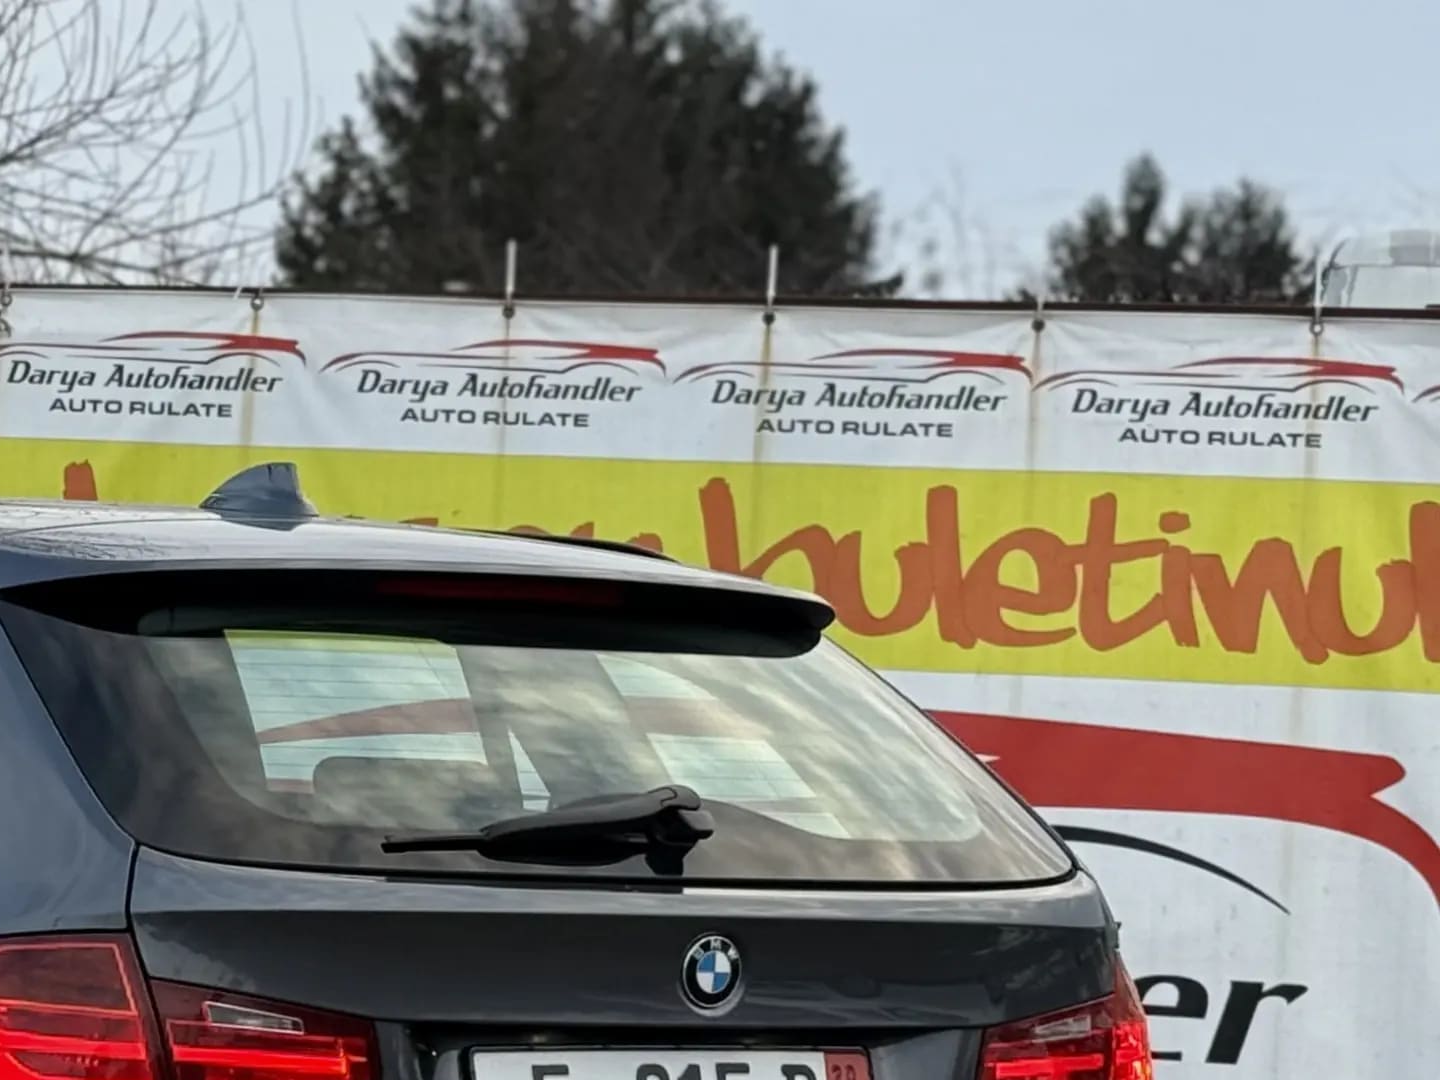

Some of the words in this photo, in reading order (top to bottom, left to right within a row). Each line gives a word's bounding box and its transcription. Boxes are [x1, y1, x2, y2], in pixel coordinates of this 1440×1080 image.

[6, 360, 96, 393] Darya
[103, 363, 283, 394] Autohandler
[357, 370, 449, 402] Darya
[456, 370, 643, 402] Autohandler
[49, 397, 123, 415] AUTO
[128, 401, 234, 419] RULATE
[711, 379, 807, 413] Darya
[815, 382, 1008, 412] Autohandler
[1071, 388, 1173, 423] Darya
[1180, 391, 1380, 423] Autohandler
[400, 408, 476, 425] AUTO
[482, 410, 590, 429] RULATE
[756, 418, 835, 436] AUTO
[841, 420, 954, 439] RULATE
[1118, 427, 1200, 446] AUTO
[1207, 429, 1323, 449] RULATE
